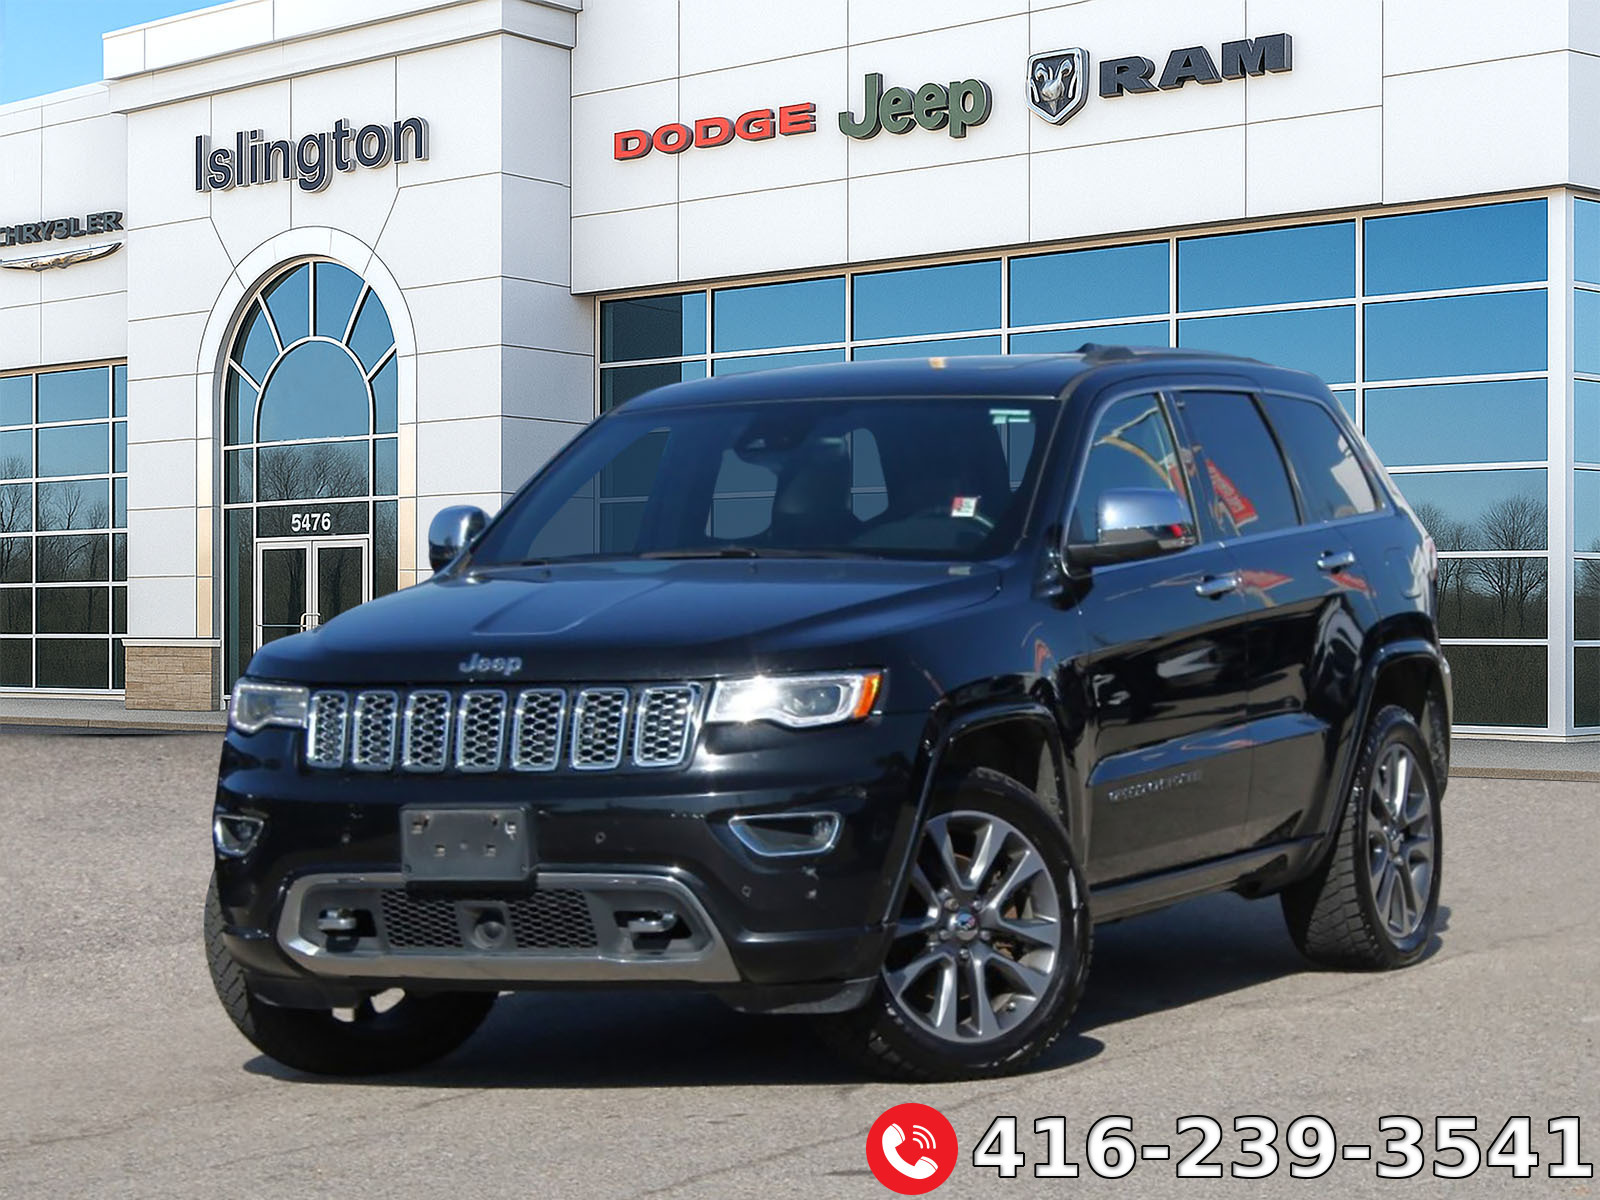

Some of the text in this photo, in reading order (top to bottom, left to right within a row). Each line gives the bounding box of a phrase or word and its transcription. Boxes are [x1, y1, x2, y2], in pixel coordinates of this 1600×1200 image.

[1100, 33, 1292, 98] RAM
[613, 102, 817, 160] DODGE
[839, 73, 992, 138] Jeep
[195, 116, 429, 192] Islington
[291, 512, 331, 532] 5476
[459, 653, 522, 676] Jeep
